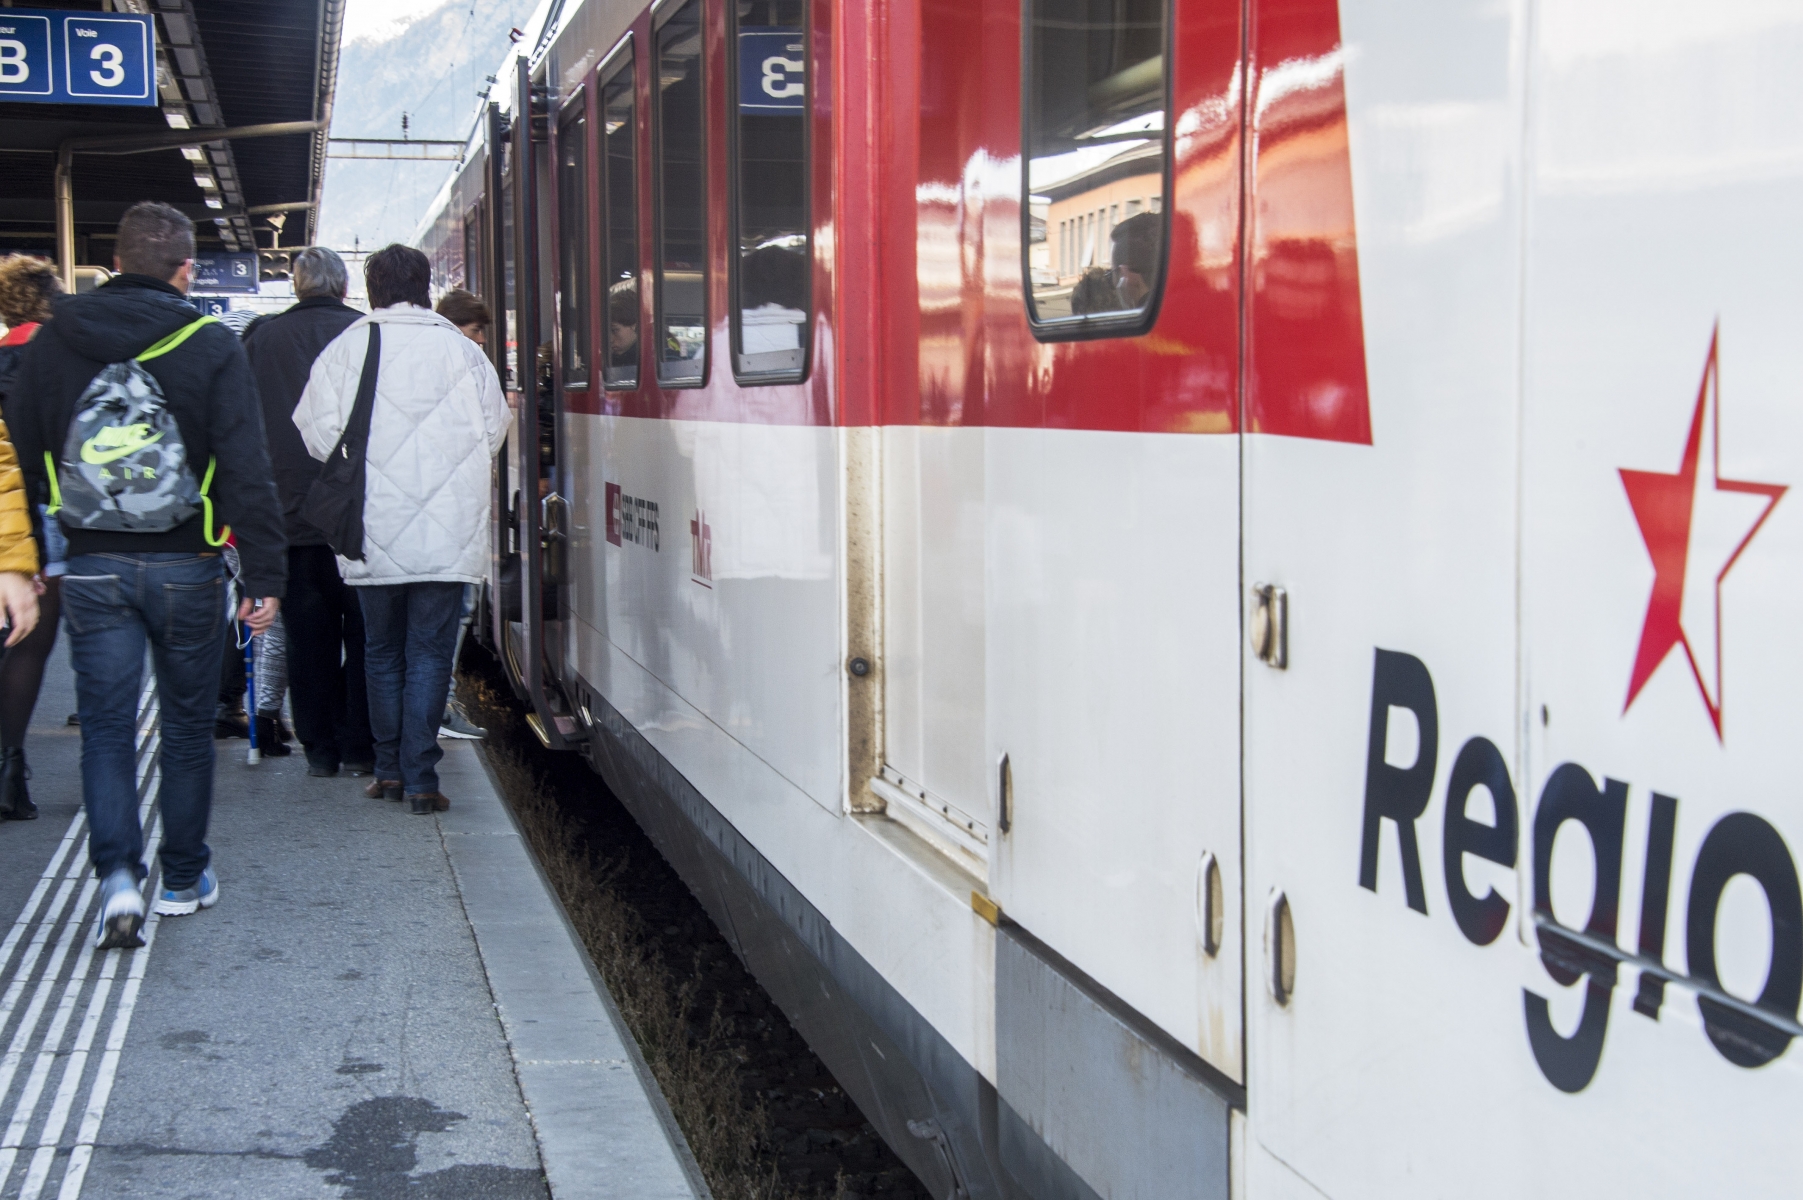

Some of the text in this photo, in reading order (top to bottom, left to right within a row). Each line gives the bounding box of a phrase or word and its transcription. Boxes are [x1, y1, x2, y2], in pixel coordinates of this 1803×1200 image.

[75, 28, 98, 38] Voie
[0, 39, 29, 84] B
[90, 43, 125, 87] 3
[236, 264, 247, 275] 3
[211, 304, 223, 318] 3
[98, 466, 157, 480] AIR
[1358, 646, 1803, 1094] Regio
